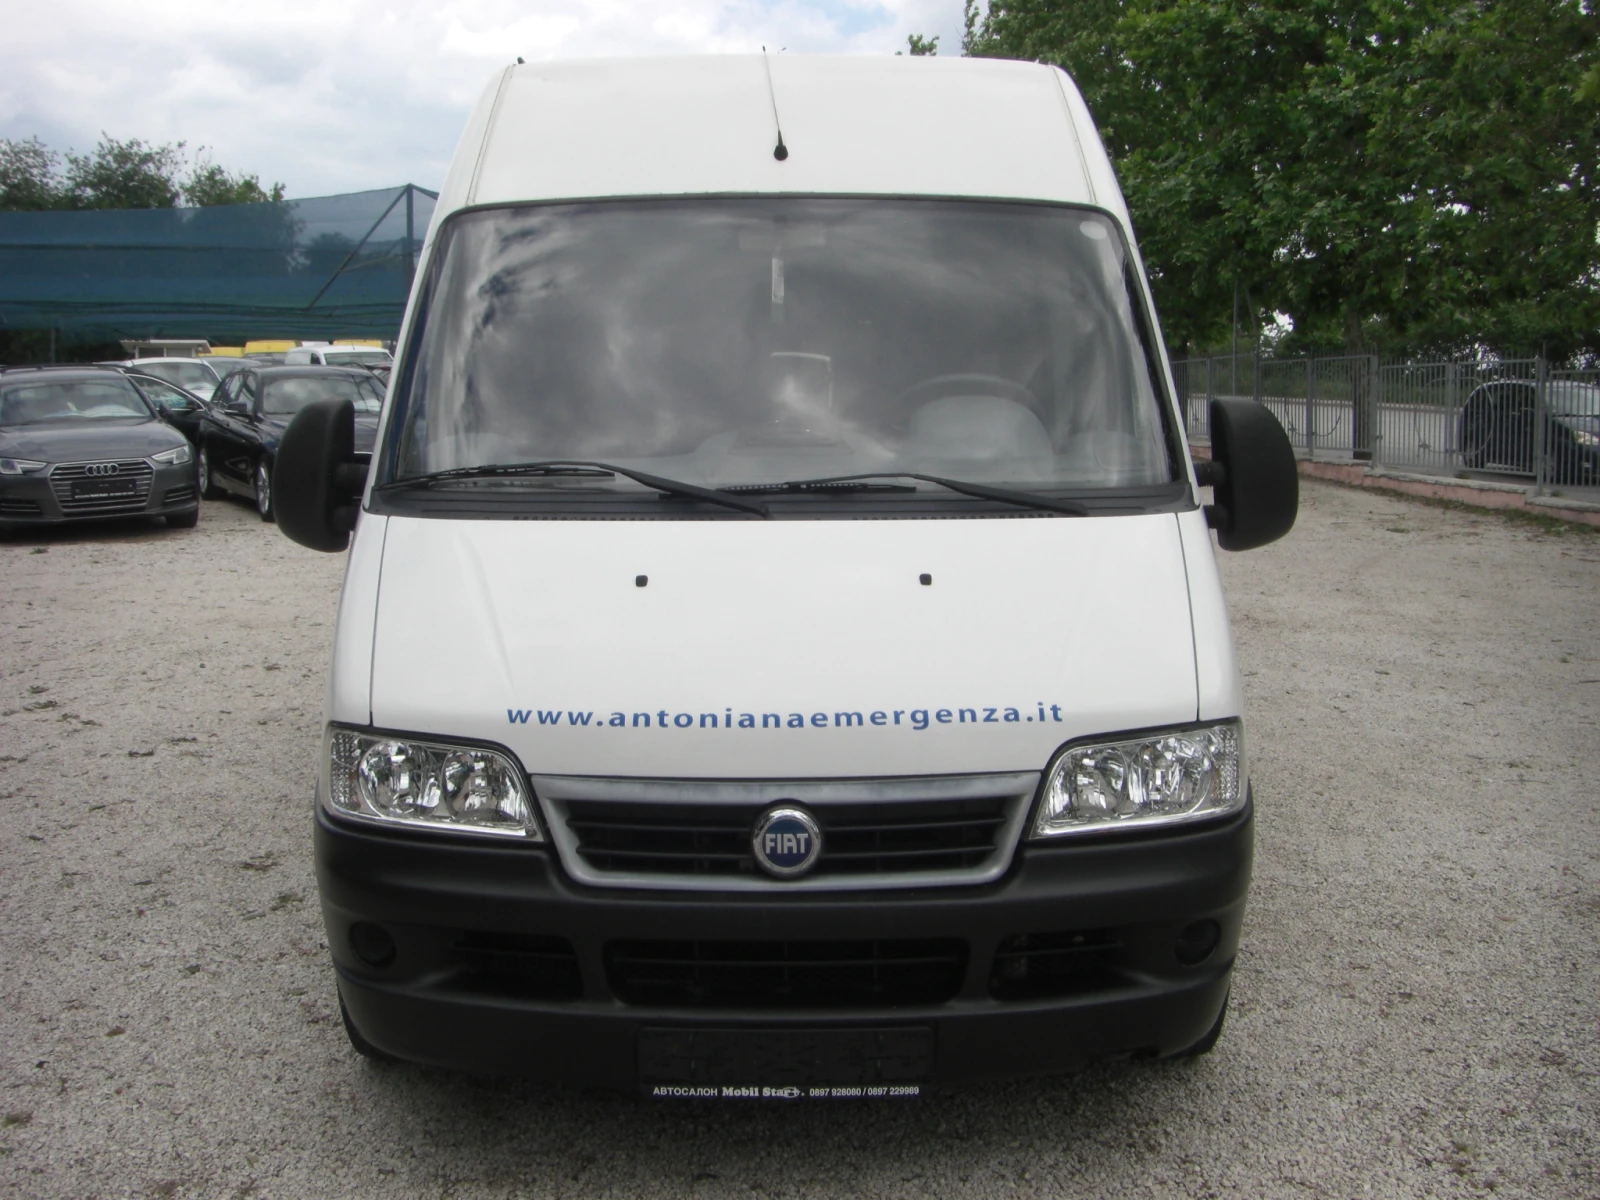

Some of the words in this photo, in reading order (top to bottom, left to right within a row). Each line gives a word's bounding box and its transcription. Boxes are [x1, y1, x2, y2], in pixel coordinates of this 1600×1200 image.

[507, 702, 1064, 730] www.antonianaemergenza.it
[765, 833, 809, 854] FIAT
[652, 1086, 718, 1097] АВТОСАЛОН
[721, 1086, 760, 1097] Mobil
[809, 1088, 829, 1097] 0897
[867, 1087, 888, 1096] 0897
